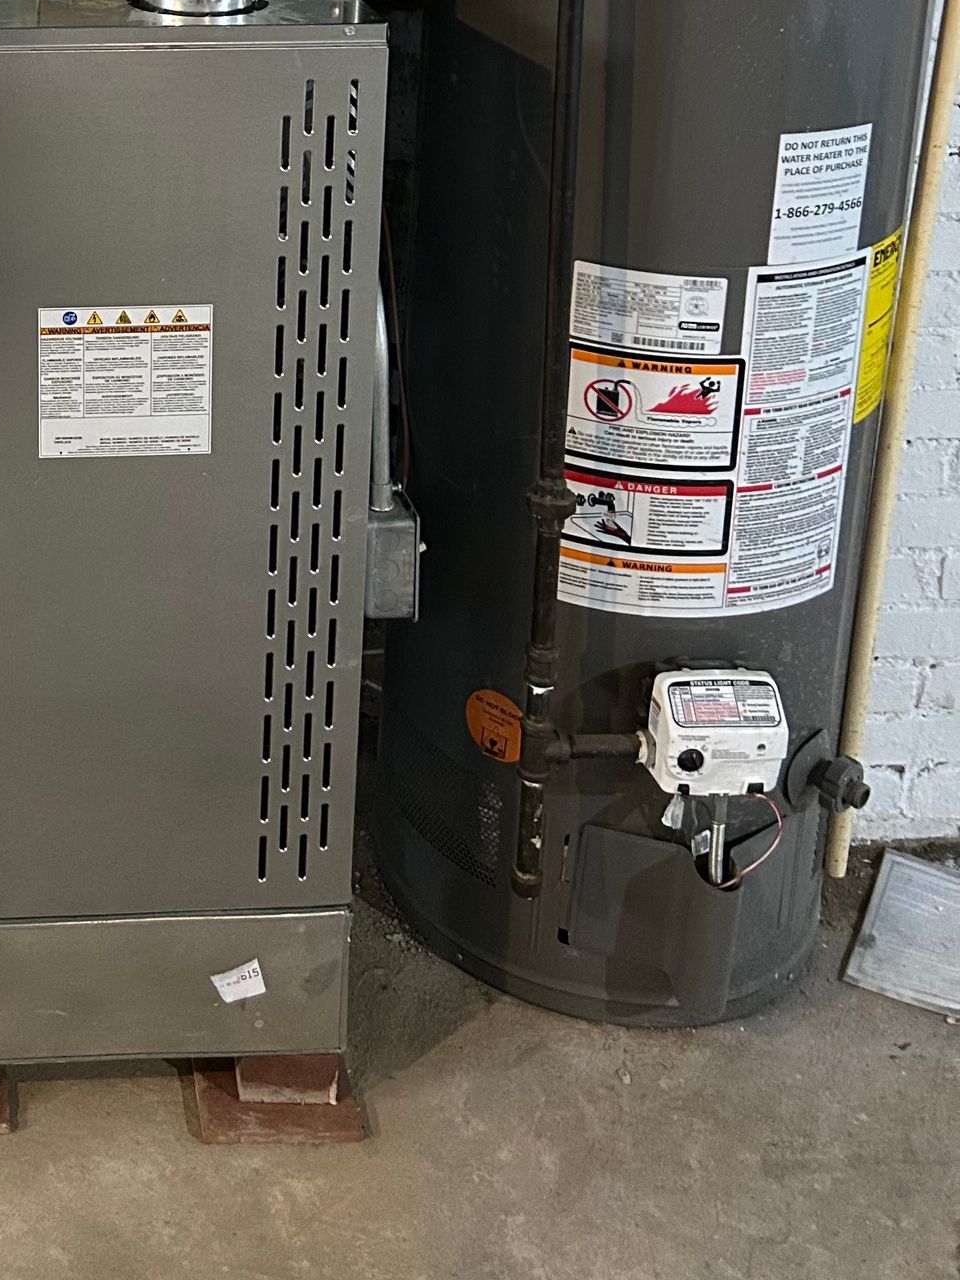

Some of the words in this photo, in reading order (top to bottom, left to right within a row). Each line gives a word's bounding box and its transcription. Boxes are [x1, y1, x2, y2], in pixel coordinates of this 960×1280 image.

[785, 142, 798, 151] DO
[801, 141, 819, 150] NOT
[820, 136, 851, 148] RETURN
[853, 133, 868, 142] THIS
[781, 155, 811, 163] WATER
[813, 150, 842, 161] HEATER
[844, 148, 854, 157] TO
[856, 145, 868, 154] THE
[785, 167, 810, 176] PLACE
[812, 164, 824, 173] OF
[825, 159, 863, 172] PURCHASE
[775, 196, 862, 219] 1-866-279-4566
[92, 326, 150, 334] AVERTISSEMENT
[160, 324, 210, 332] ADVERTENCIA
[632, 360, 693, 374] WARNING
[627, 483, 678, 494] DANGER
[622, 561, 673, 573] WARNING
[476, 695, 485, 704] DO
[486, 701, 500, 713] NOT
